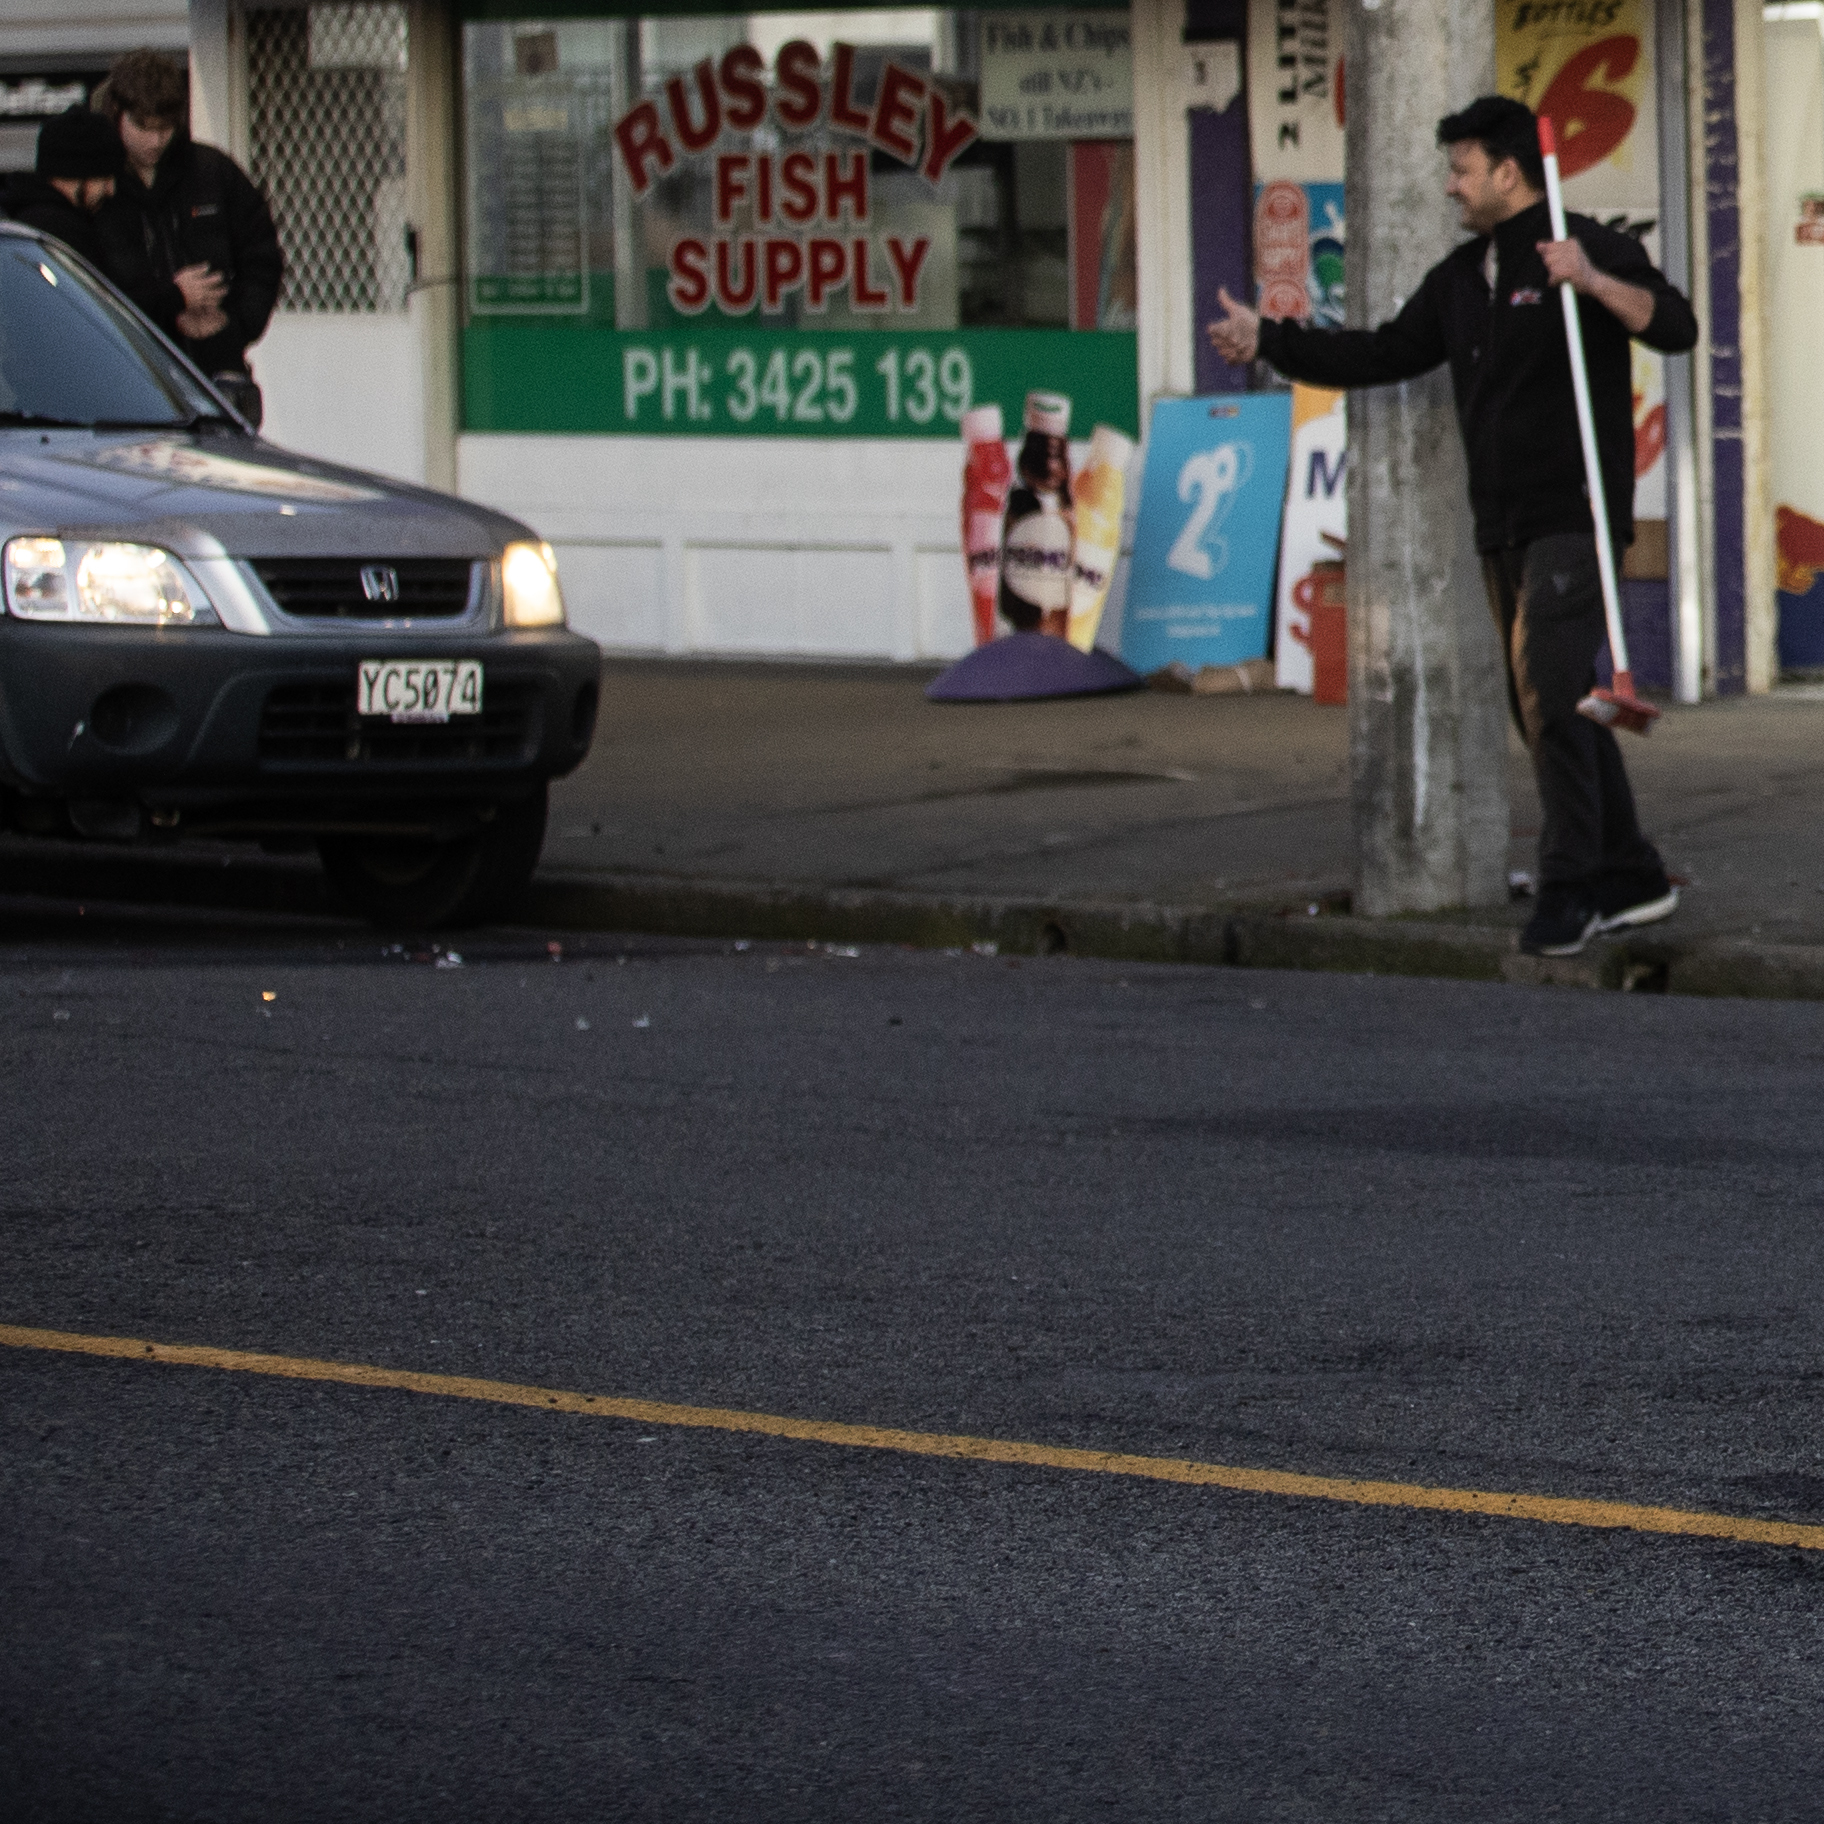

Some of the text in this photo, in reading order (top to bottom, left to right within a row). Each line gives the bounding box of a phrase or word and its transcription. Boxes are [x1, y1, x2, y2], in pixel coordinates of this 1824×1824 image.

[614, 39, 978, 194] RUSSLEY
[716, 152, 870, 224] FISH
[669, 237, 930, 311] SUPPLY
[623, 347, 974, 421] PH: 3425 139
[362, 666, 479, 712] YC5074
